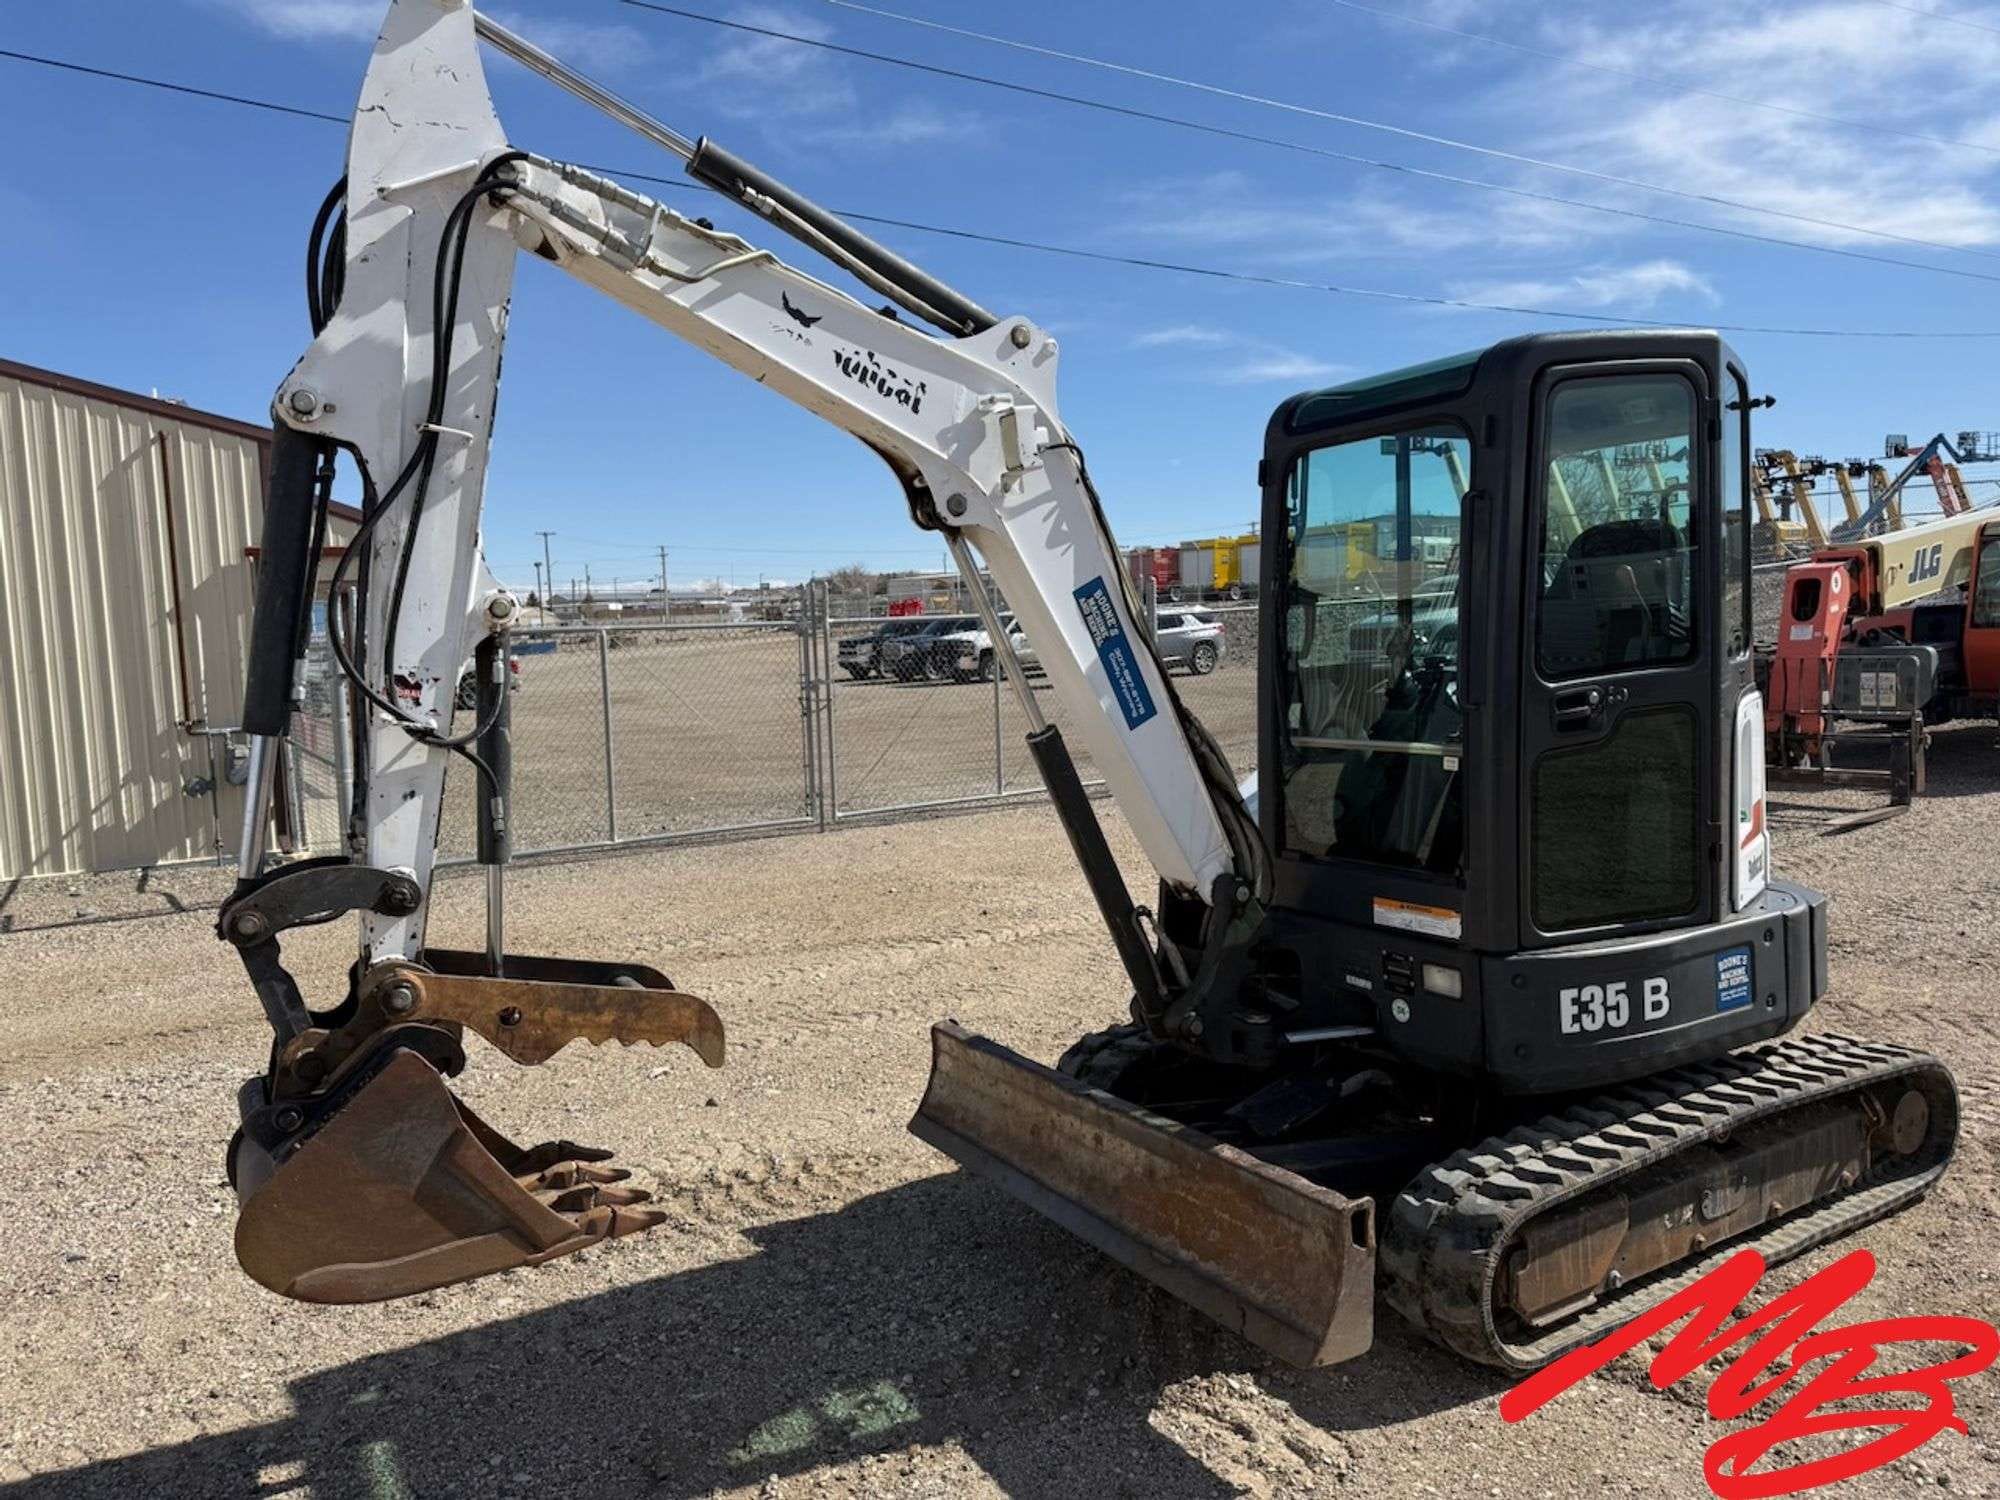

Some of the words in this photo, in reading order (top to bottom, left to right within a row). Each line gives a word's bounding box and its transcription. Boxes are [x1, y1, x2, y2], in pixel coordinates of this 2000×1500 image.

[1908, 543, 1942, 584] JLG
[1088, 597, 1109, 641] MACHINE
[1094, 589, 1119, 636] BOONE'S
[1560, 981, 1629, 1034] E35
[1643, 977, 1670, 1021] B
